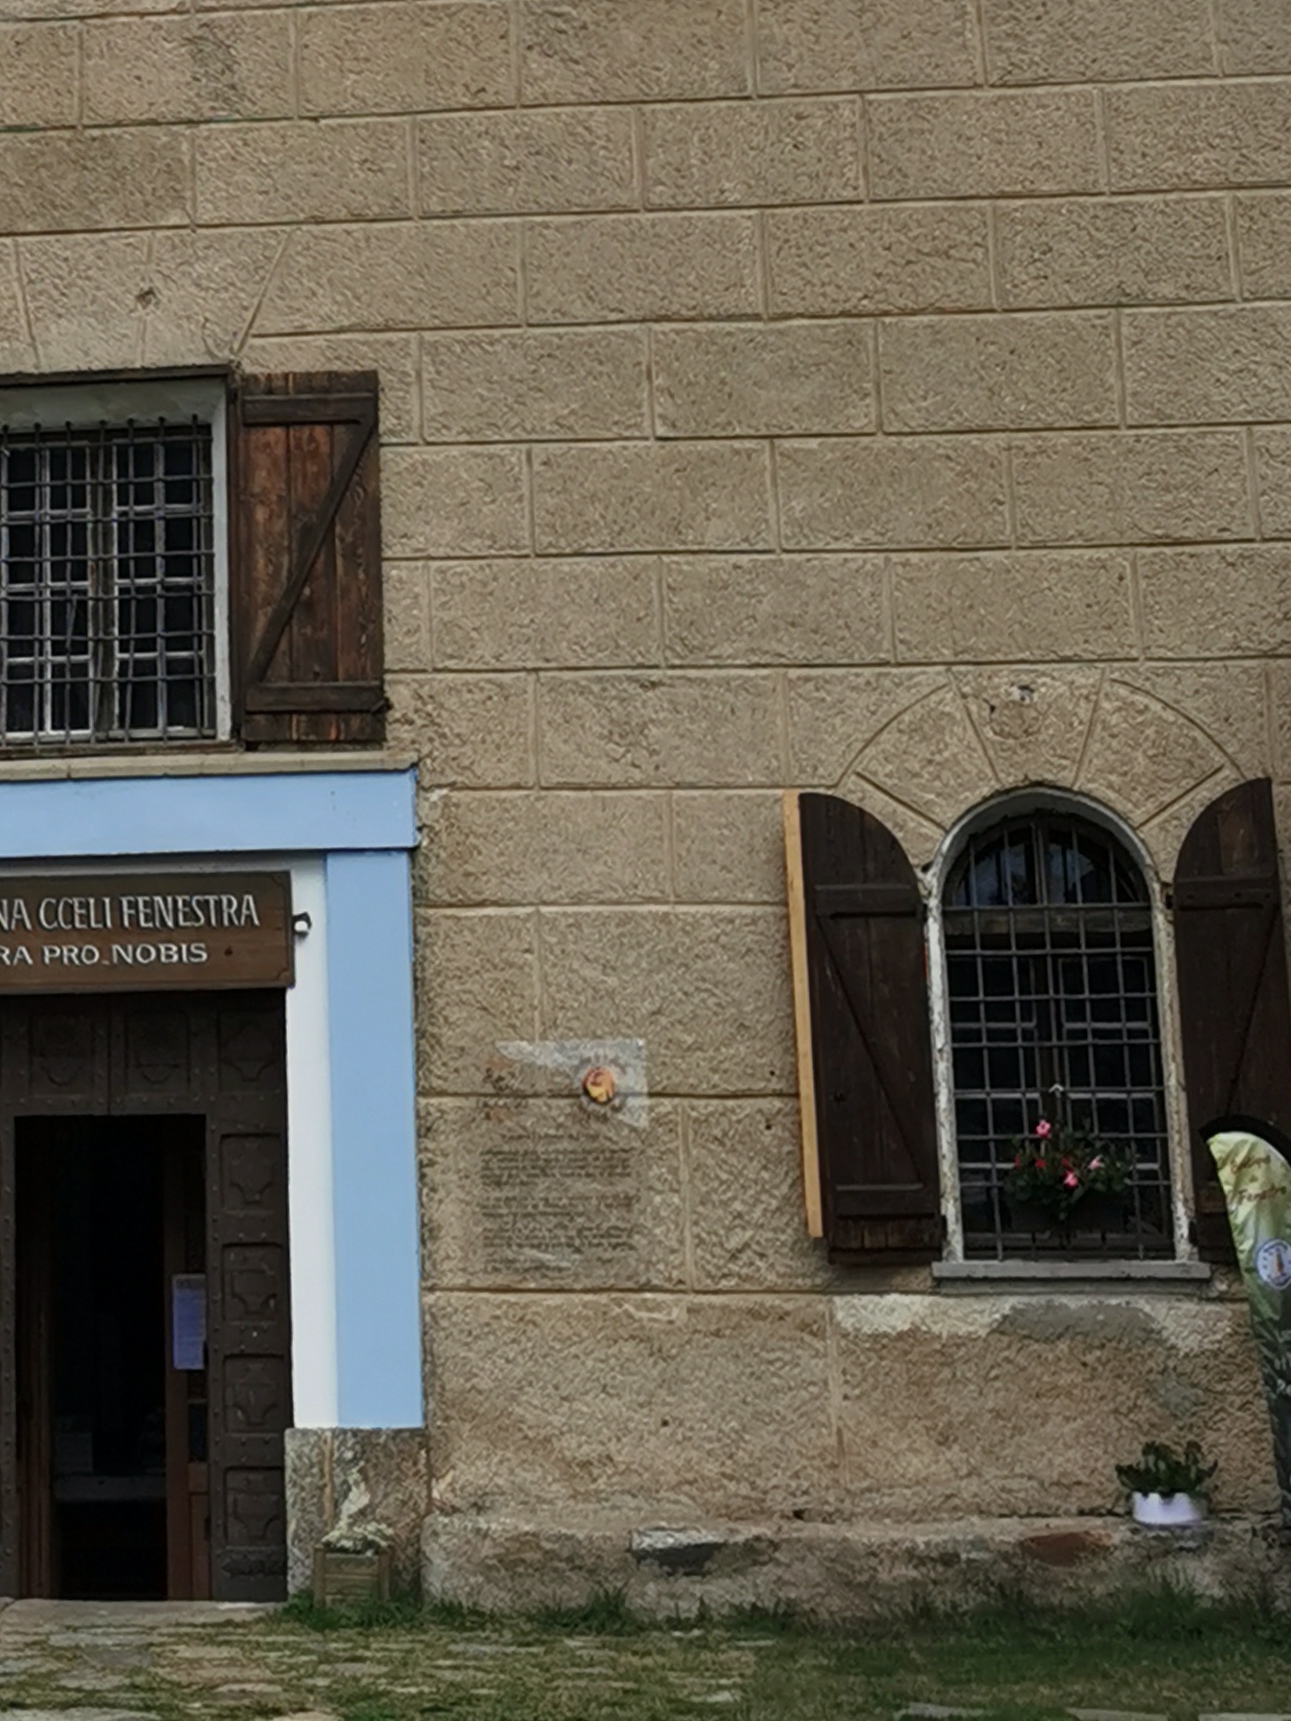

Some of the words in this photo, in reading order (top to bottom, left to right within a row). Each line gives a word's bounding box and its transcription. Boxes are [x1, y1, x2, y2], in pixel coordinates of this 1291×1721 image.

[120, 893, 260, 929] FENESTRA
[42, 943, 101, 966] PRO
[111, 941, 208, 965] NOBIS
